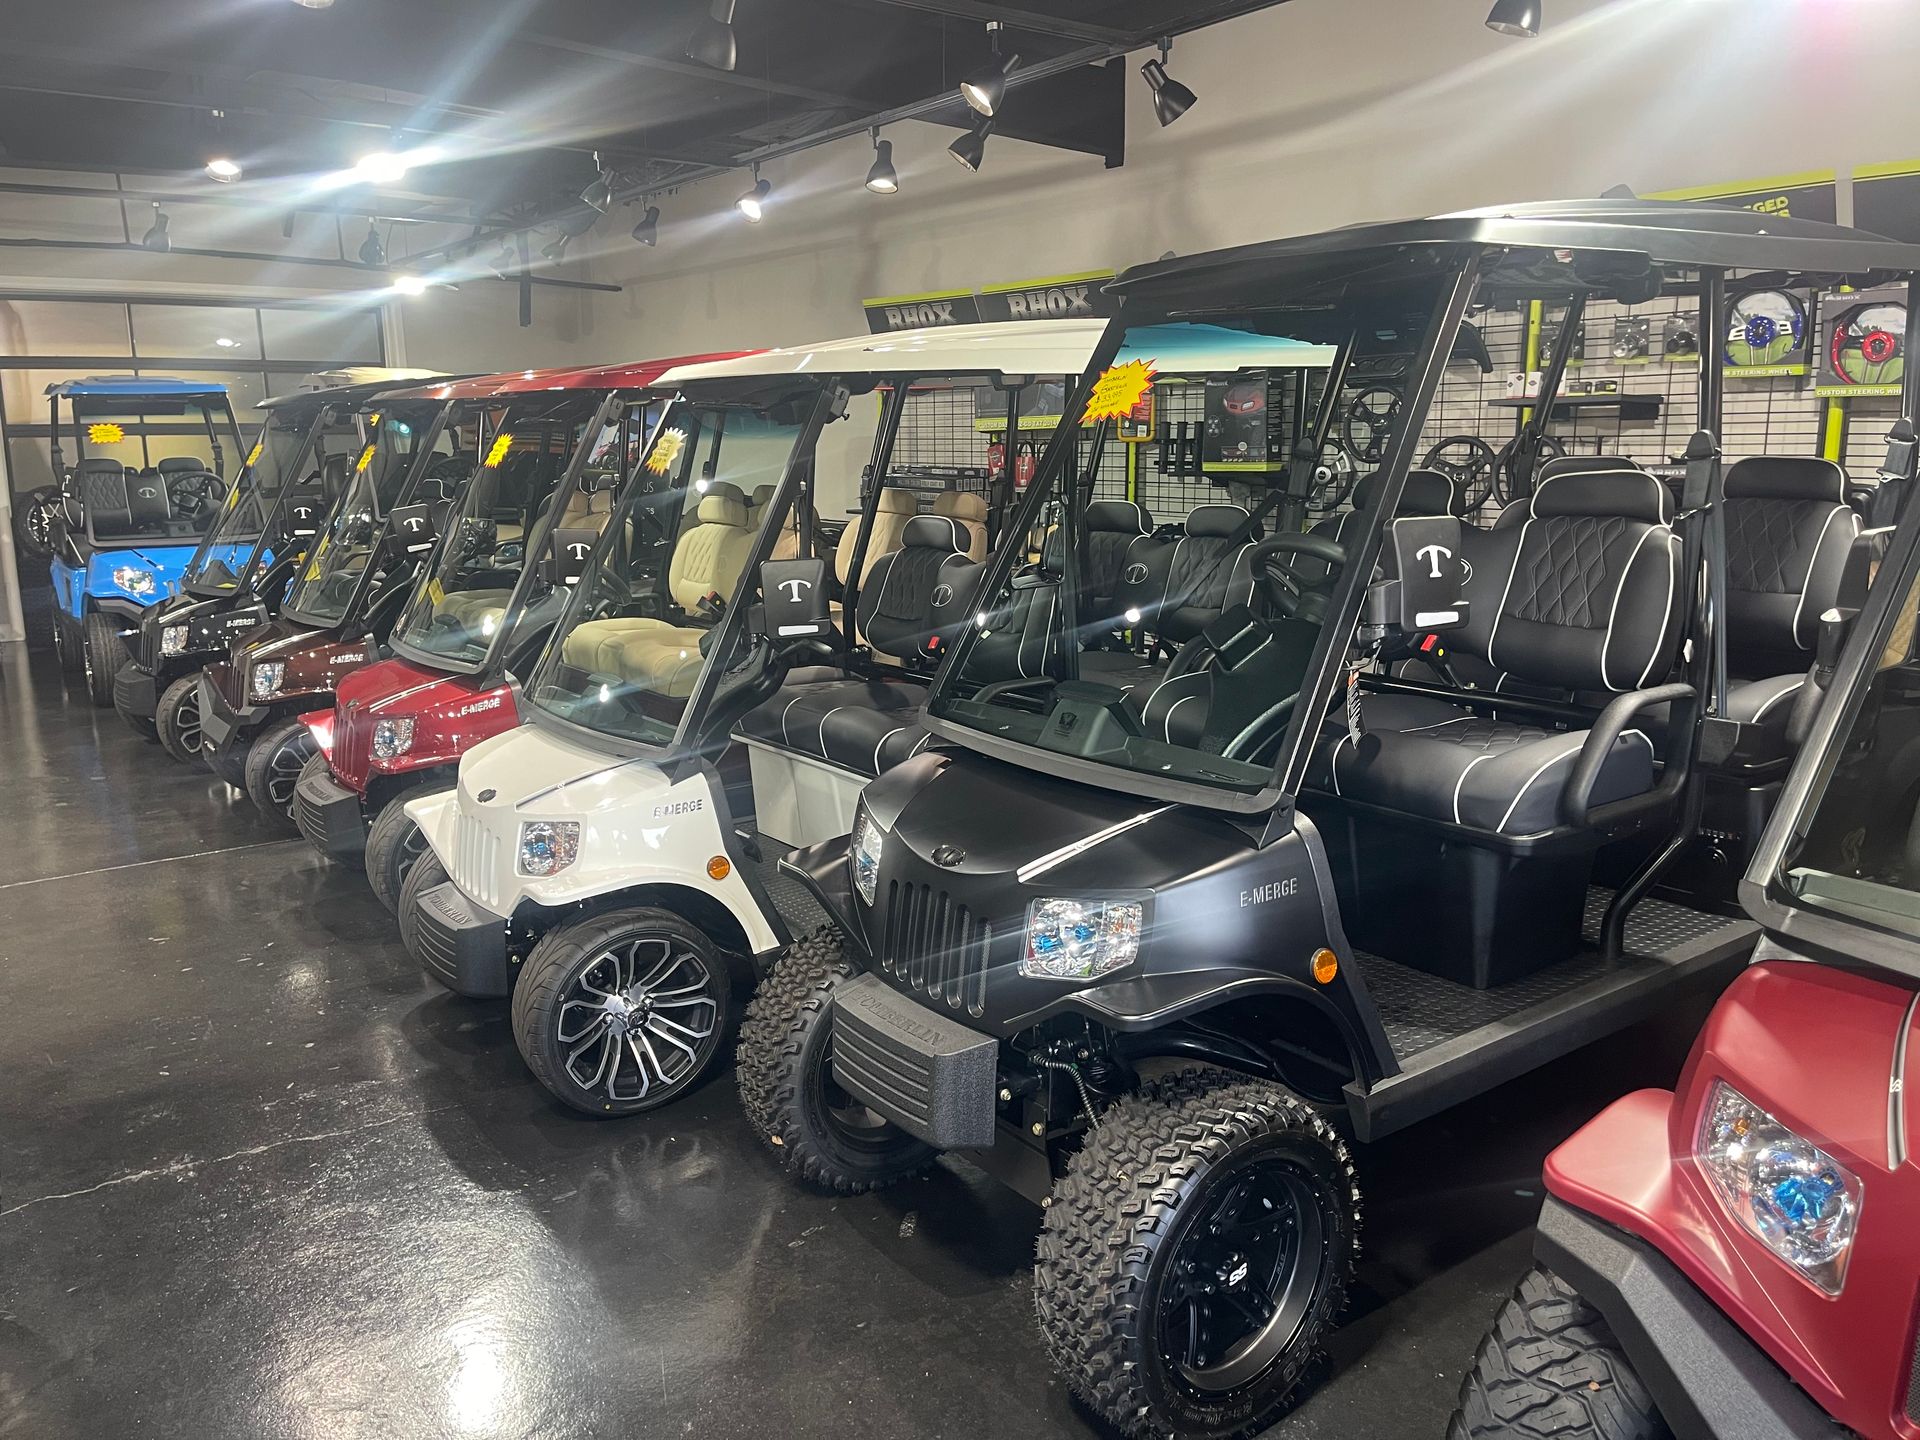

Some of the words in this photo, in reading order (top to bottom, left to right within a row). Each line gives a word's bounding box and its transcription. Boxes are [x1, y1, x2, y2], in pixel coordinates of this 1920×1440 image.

[1006, 285, 1092, 319] RHOX
[884, 301, 957, 330] RHOX
[1816, 388, 1846, 396] CUSTOM
[1848, 388, 1884, 396] STEERING
[566, 542, 591, 560] T
[1416, 544, 1452, 578] T
[777, 579, 812, 603] T
[461, 697, 501, 715] E-MERGE
[1240, 877, 1298, 908] E-MERGE
